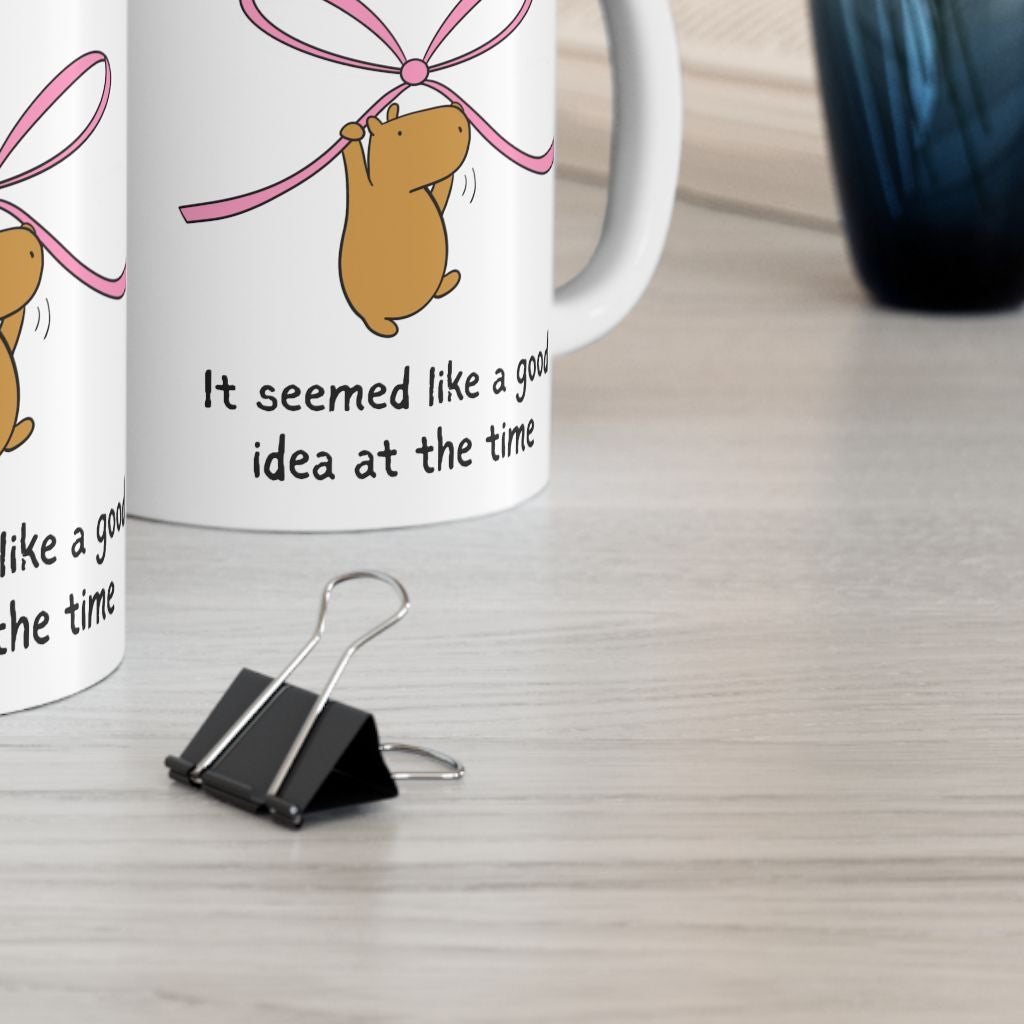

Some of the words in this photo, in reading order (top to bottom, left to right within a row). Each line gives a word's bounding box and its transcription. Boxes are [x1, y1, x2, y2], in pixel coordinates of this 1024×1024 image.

[205, 369, 237, 410] It
[256, 366, 409, 412] seemed
[429, 360, 479, 406] like
[493, 368, 506, 394] a
[254, 434, 335, 481] idea
[355, 440, 398, 479] at
[416, 426, 472, 473] the
[486, 419, 534, 461] time
[0, 523, 56, 577] like
[71, 527, 86, 557] a
[65, 581, 114, 635] time
